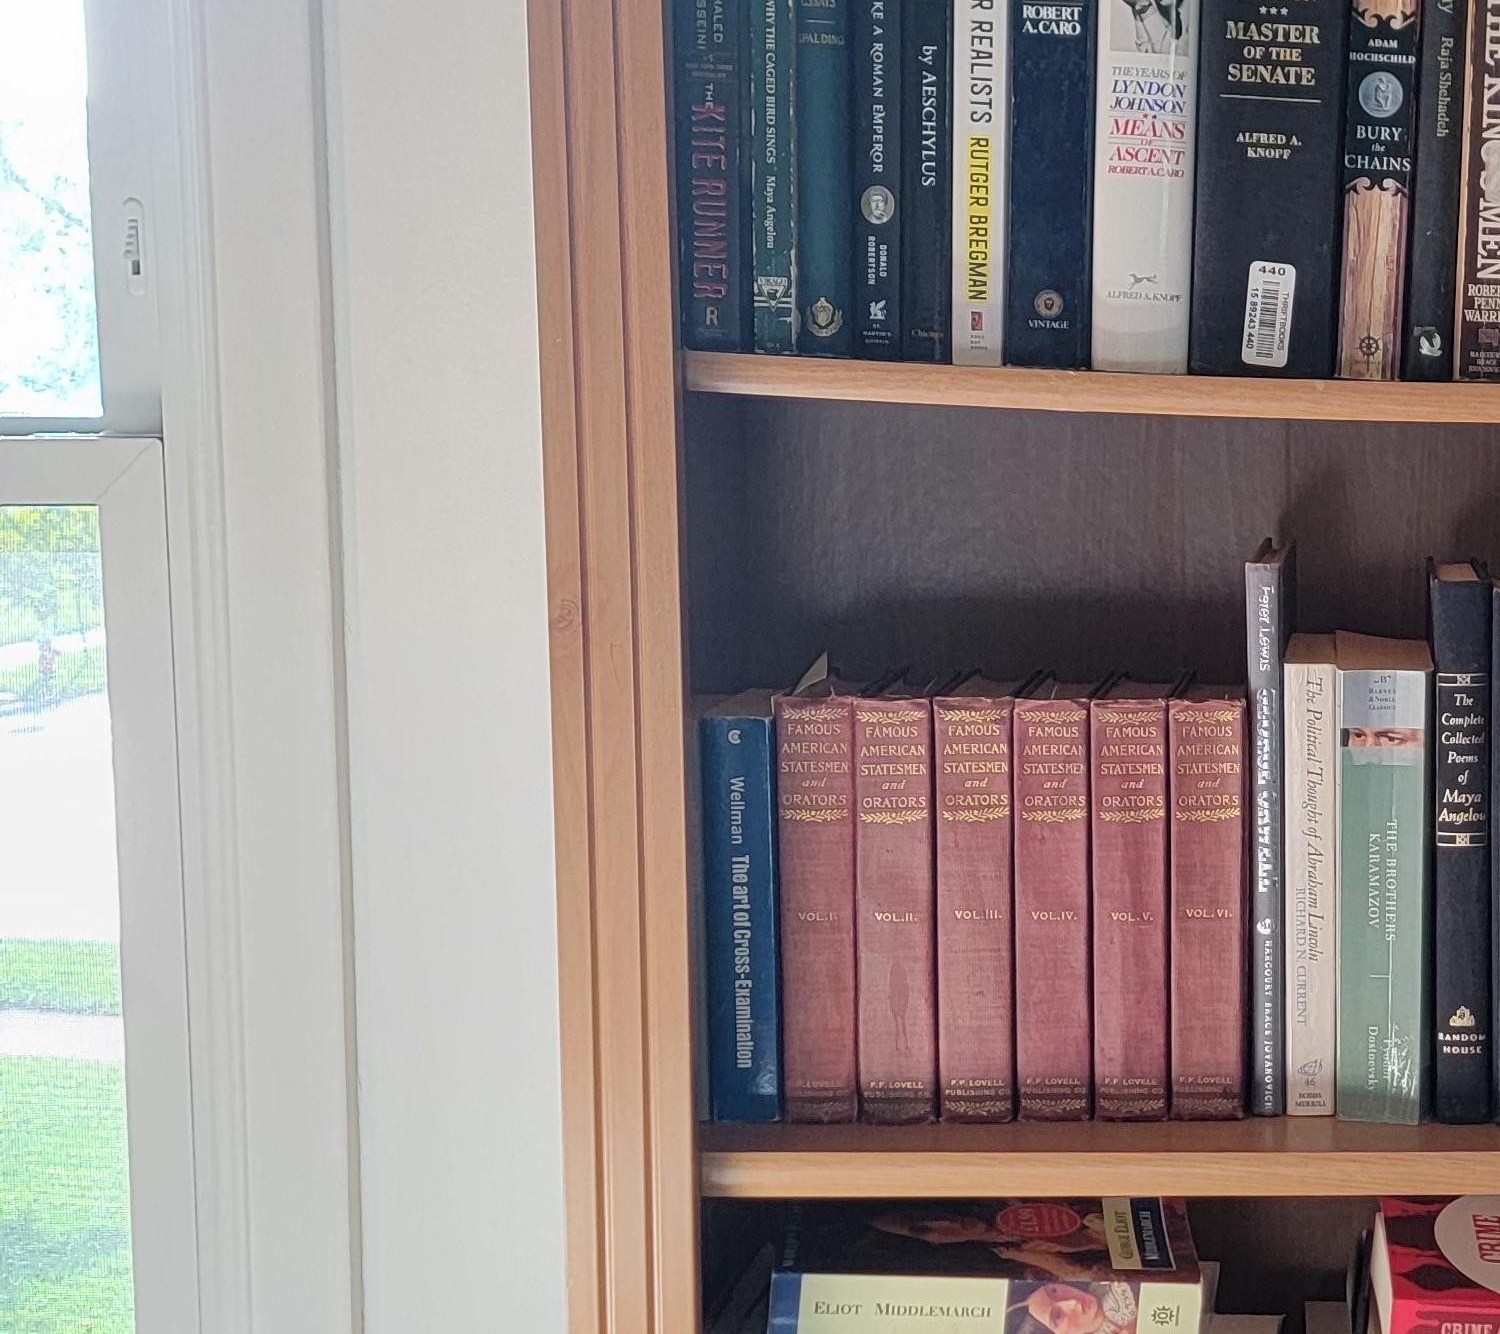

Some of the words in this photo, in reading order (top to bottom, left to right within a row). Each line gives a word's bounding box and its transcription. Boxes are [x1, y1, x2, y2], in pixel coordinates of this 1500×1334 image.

[765, 27, 776, 51] THE
[919, 45, 936, 65] by
[764, 52, 776, 95] CAGED
[969, 20, 995, 125] REALISTS
[704, 83, 714, 109] THE
[765, 96, 776, 125] BIRD
[691, 103, 726, 171] KITE
[921, 70, 937, 188] AESCHYLUS
[1356, 124, 1402, 141] BURY
[765, 128, 776, 163] SINGS
[969, 136, 989, 207] RUTGER
[1344, 154, 1411, 171] CHAINS
[691, 178, 728, 299] RUNNER
[967, 213, 989, 302] BREGMAN
[1258, 265, 1286, 277] 440
[1277, 292, 1289, 351] THRIFTBOOKS
[1305, 676, 1323, 706] The
[948, 725, 1000, 738] FAMOUS
[1305, 708, 1323, 763] Political
[944, 743, 1007, 756] AMERICAN
[944, 762, 1008, 775] STATESMEN
[965, 778, 987, 789] and
[1304, 764, 1324, 824] Thought
[729, 776, 746, 845] Wellman
[945, 793, 1008, 806] ORATORS
[1306, 826, 1323, 840] of
[731, 855, 750, 884] The
[1306, 841, 1324, 910] Abraham
[1367, 833, 1381, 929] KARAMAZOV
[732, 886, 748, 908] art
[733, 912, 751, 927] of
[1305, 912, 1324, 962] Lincoln
[734, 929, 754, 1068] Cross-Examination
[813, 1301, 863, 1316] ELIOT
[874, 1303, 991, 1318] MIDDLEMARCH
